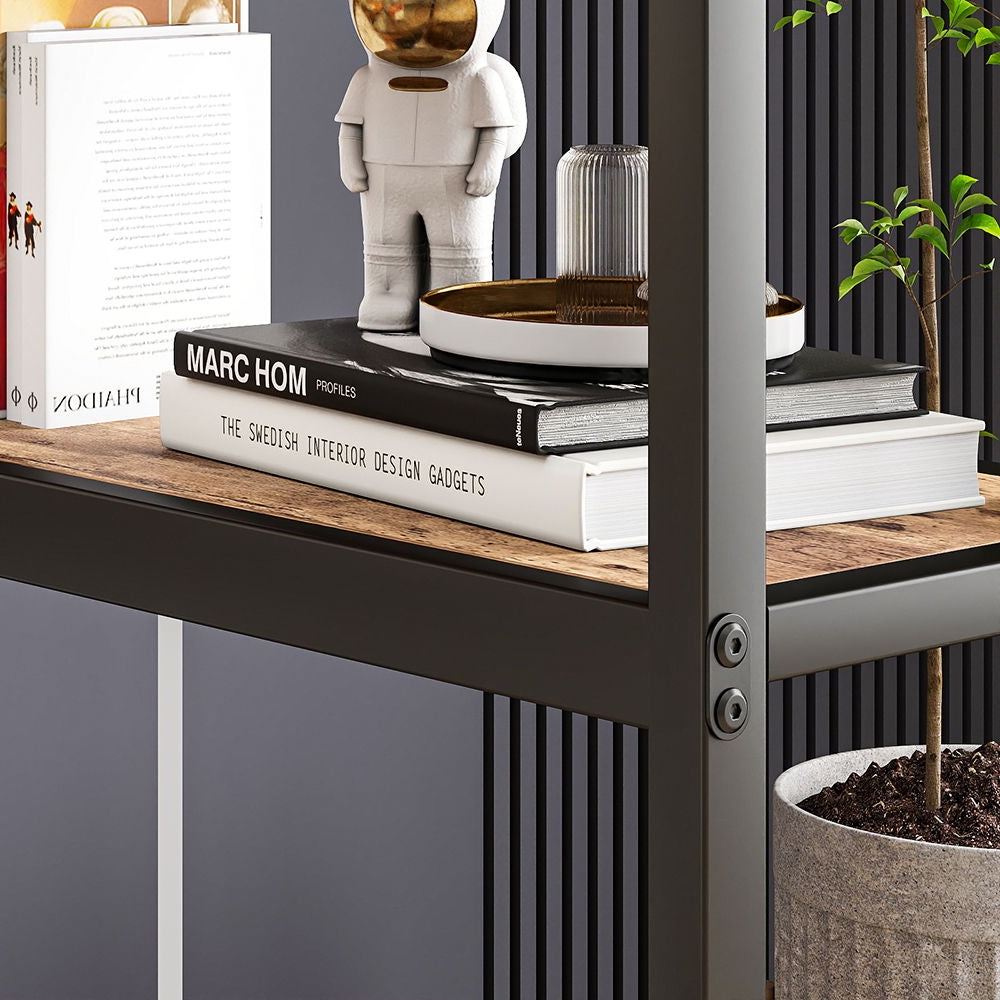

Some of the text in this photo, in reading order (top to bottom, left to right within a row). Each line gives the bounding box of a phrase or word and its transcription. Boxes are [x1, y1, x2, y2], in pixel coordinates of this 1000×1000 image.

[186, 343, 250, 383] MARC
[255, 358, 307, 396] HOM
[316, 378, 357, 399] PROFILES
[221, 415, 486, 496] THE SWEDISH INTERIOR DESIGN GADGETS
